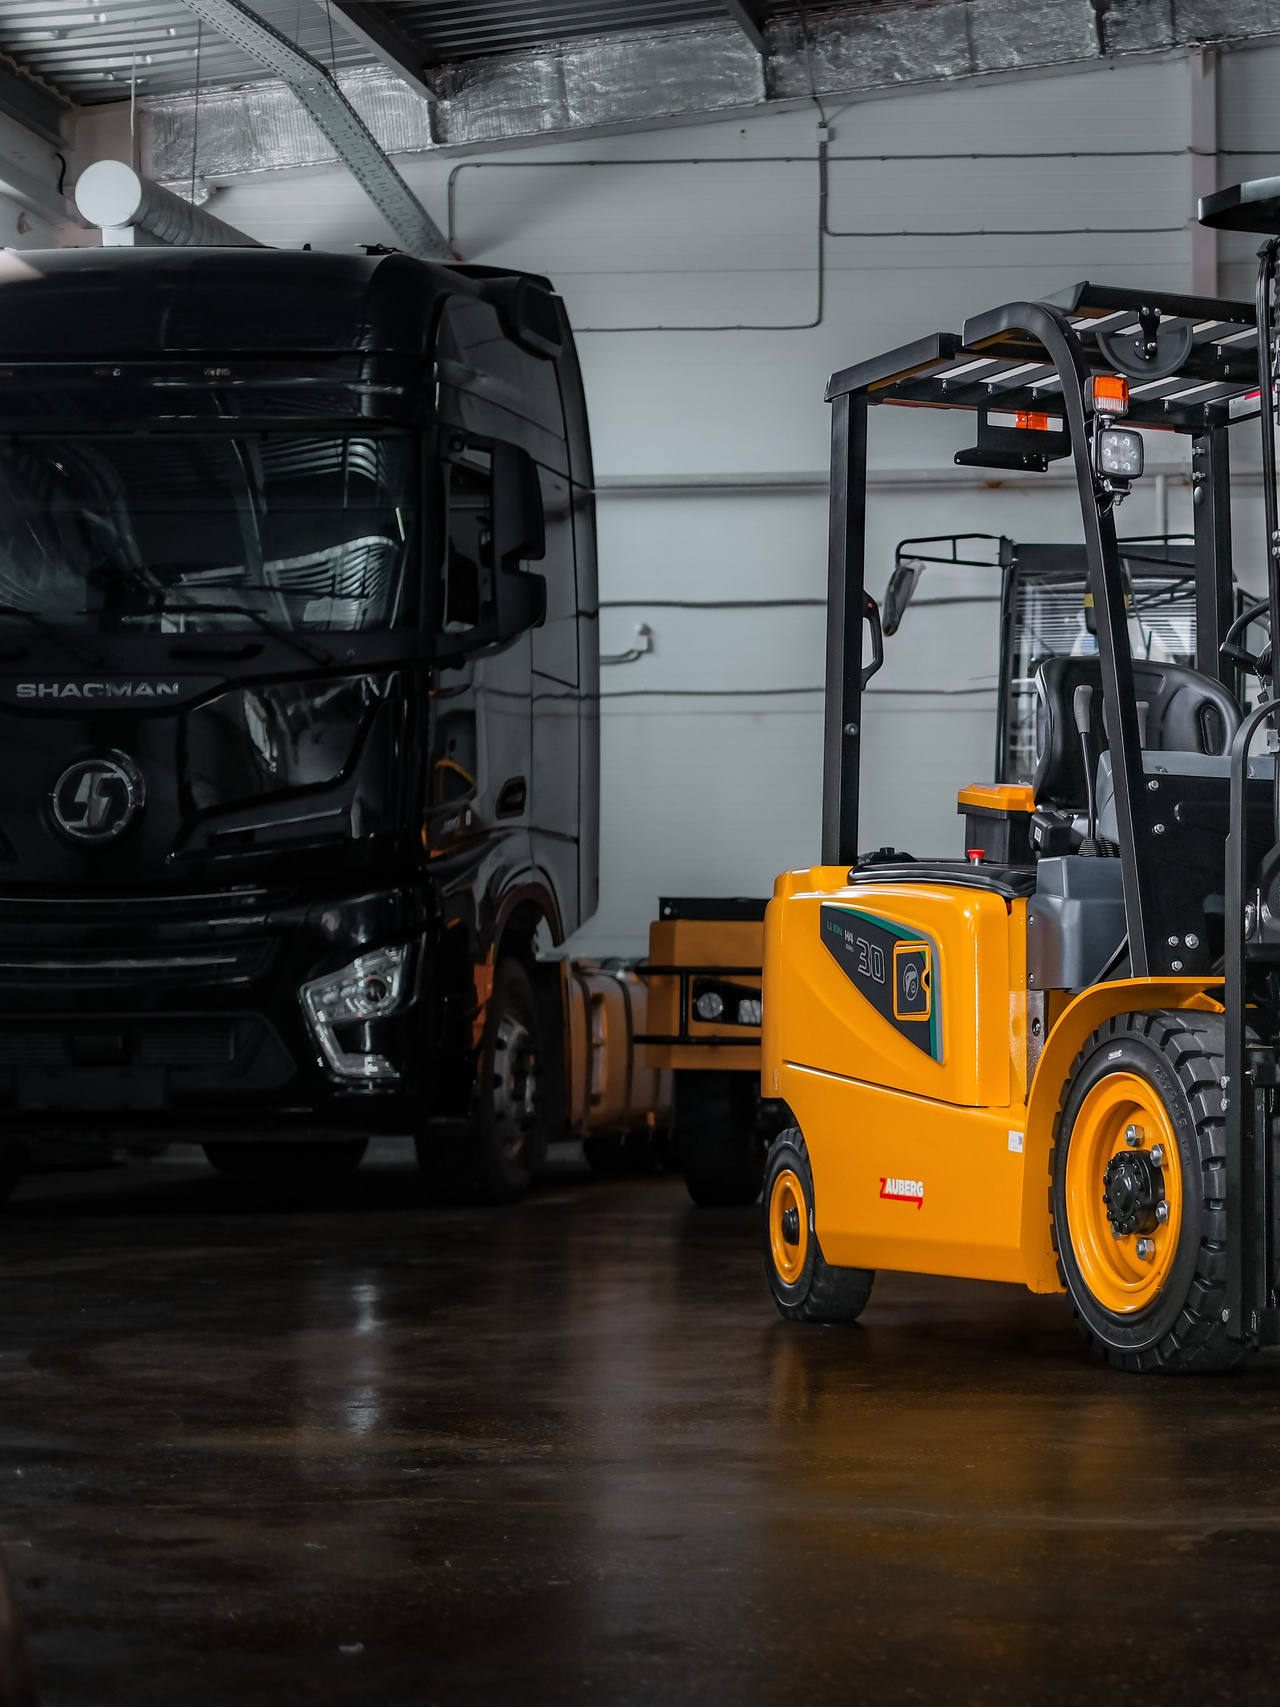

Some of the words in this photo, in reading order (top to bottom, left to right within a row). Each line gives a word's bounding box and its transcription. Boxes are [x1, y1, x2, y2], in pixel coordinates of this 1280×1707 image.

[16, 682, 179, 698] SHACMAN
[856, 936, 886, 985] 30
[880, 1177, 924, 1203] ZAUBERG
